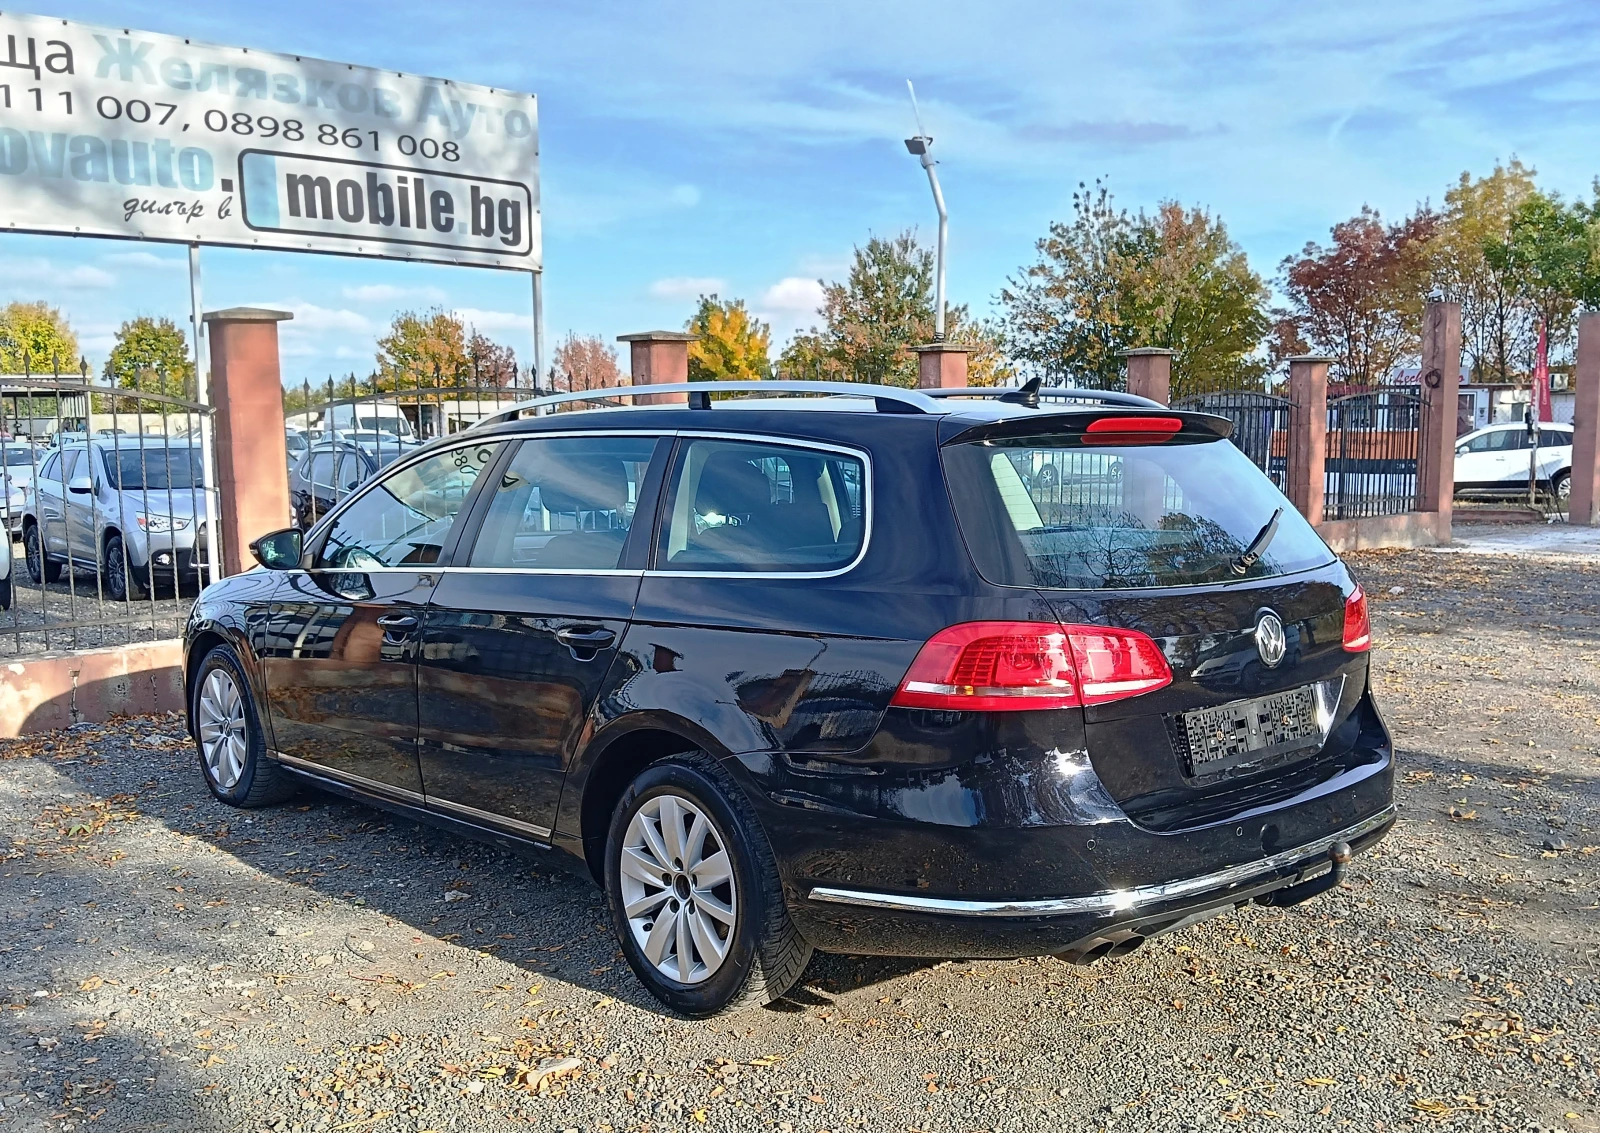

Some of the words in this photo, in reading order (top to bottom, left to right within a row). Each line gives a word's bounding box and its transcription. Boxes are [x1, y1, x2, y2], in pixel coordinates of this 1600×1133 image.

[0, 84, 73, 114] 111
[96, 96, 190, 132] 007,
[204, 109, 305, 142] 0898
[317, 123, 380, 152] 861
[397, 135, 461, 162] 008
[92, 34, 402, 120] Желязков
[416, 85, 532, 139] Ауто
[123, 198, 205, 223] дилър
[217, 196, 232, 220] в
[286, 171, 522, 247] mobile.bg
